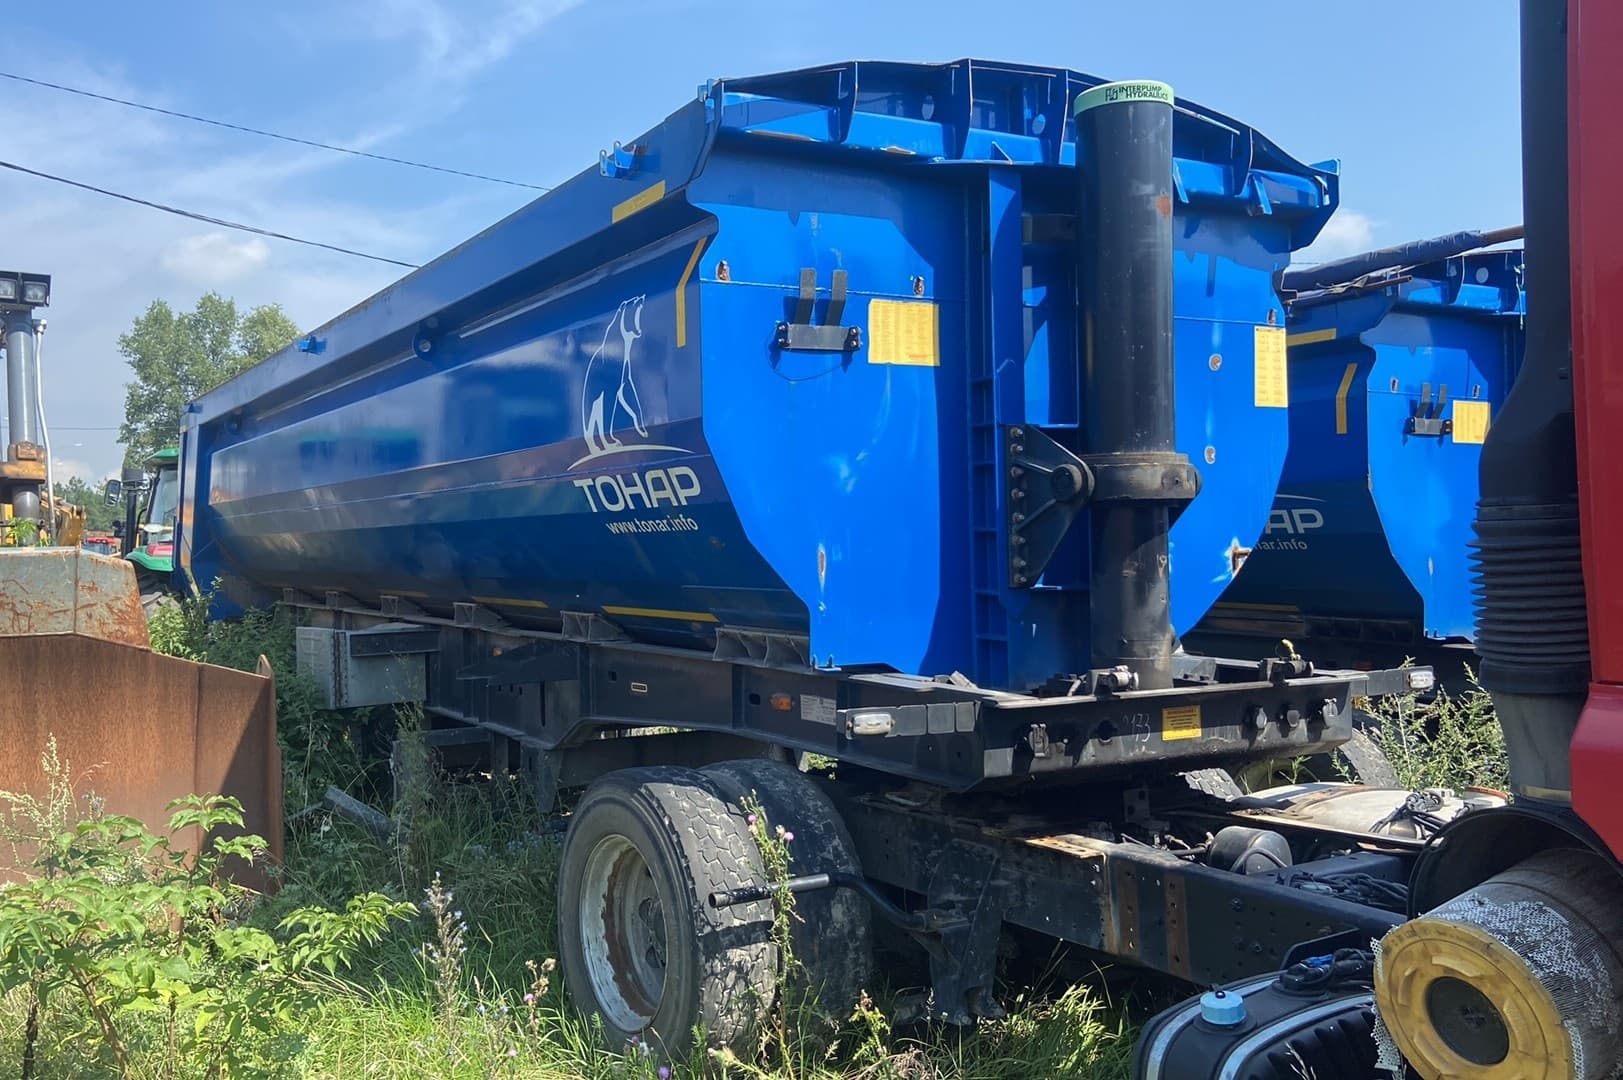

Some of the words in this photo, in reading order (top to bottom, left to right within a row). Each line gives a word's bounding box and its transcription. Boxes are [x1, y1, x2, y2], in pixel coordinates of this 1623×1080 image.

[1119, 84, 1162, 93] INTERPUMP
[1126, 90, 1168, 100] HYDRAULICS
[573, 466, 701, 513] ТОНАР
[606, 514, 699, 535] www.tonar.info
